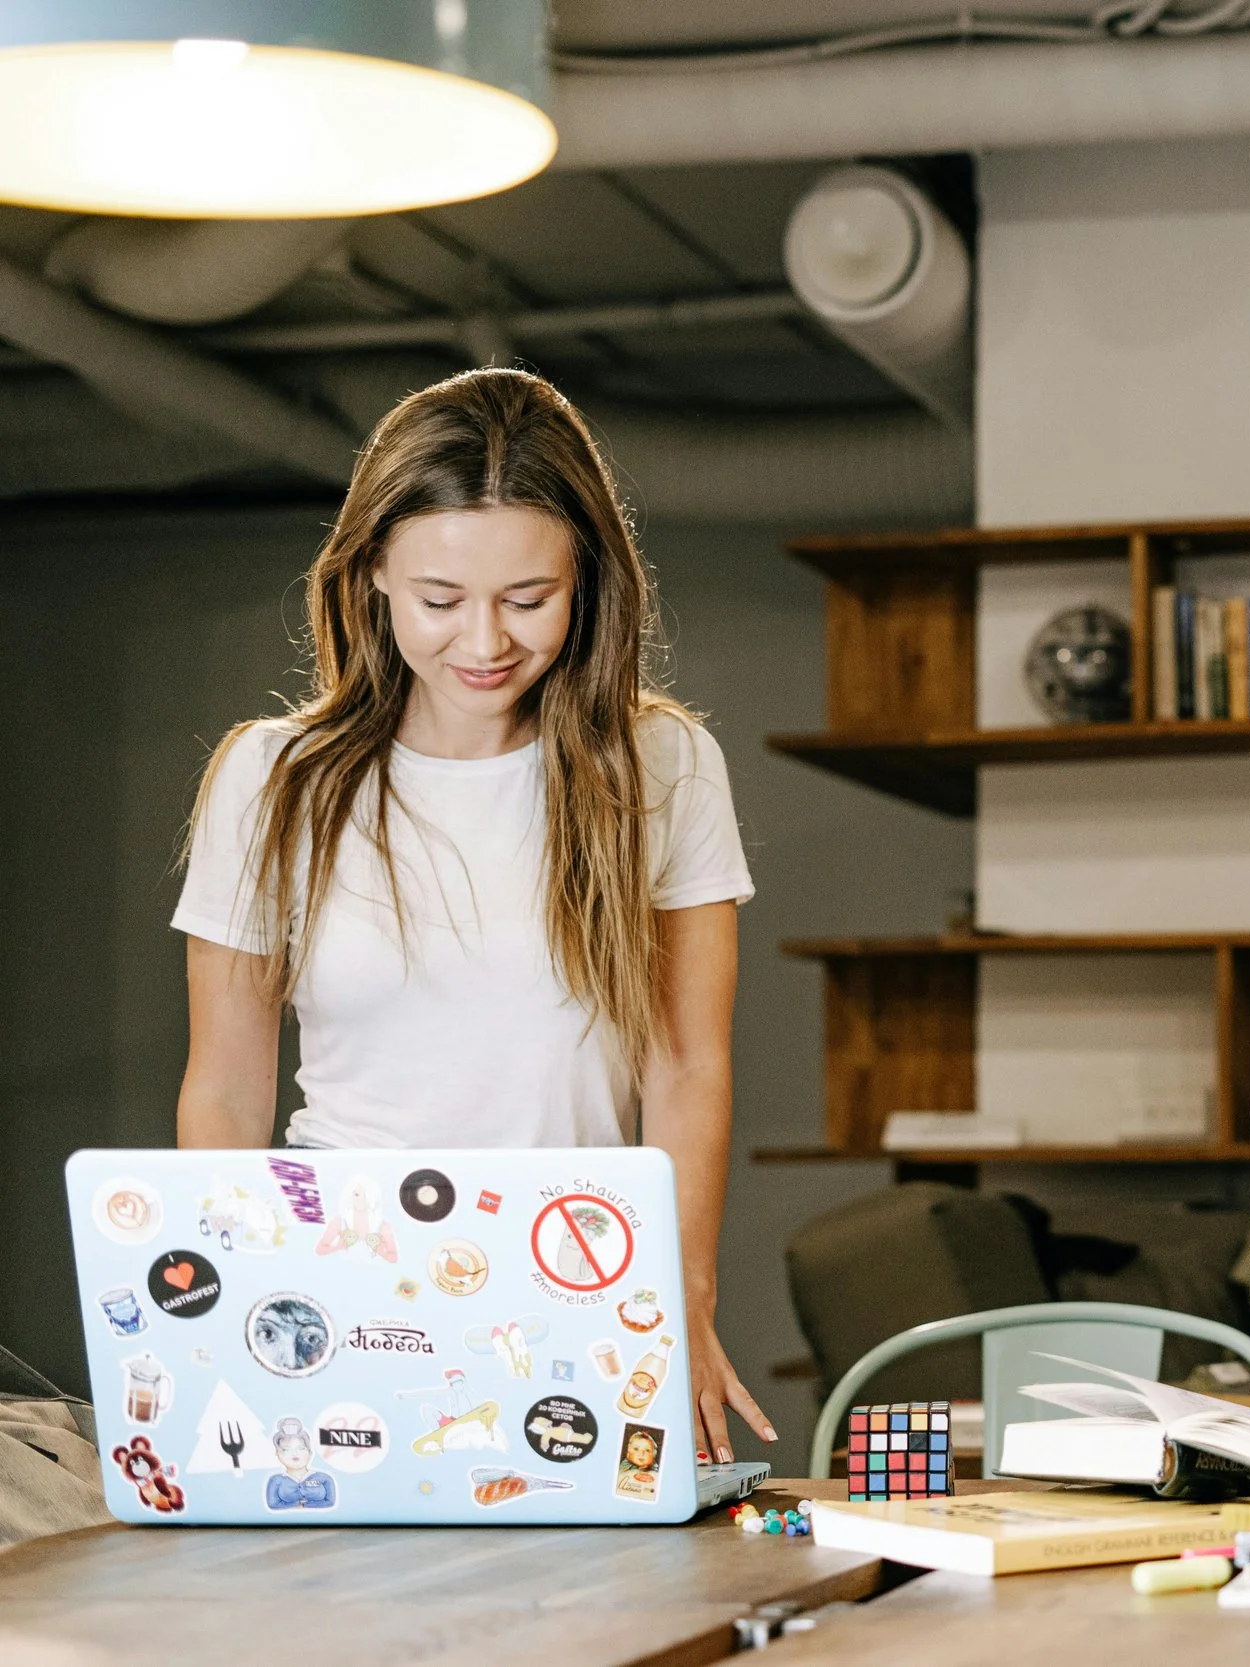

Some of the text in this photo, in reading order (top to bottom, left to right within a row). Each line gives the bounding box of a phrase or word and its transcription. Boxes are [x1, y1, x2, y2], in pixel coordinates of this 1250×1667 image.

[539, 1179, 643, 1229] No Shaurma
[169, 1254, 175, 1263] I
[162, 1282, 219, 1311] GASTROFEST
[530, 1271, 606, 1305] #moreless
[369, 1319, 409, 1327] ФАБРИКА
[330, 1431, 372, 1445] NINE
[1044, 1540, 1092, 1558] ENGLISH
[1095, 1536, 1152, 1554] GRAMMAR
[1158, 1530, 1217, 1547] REFERENCE
